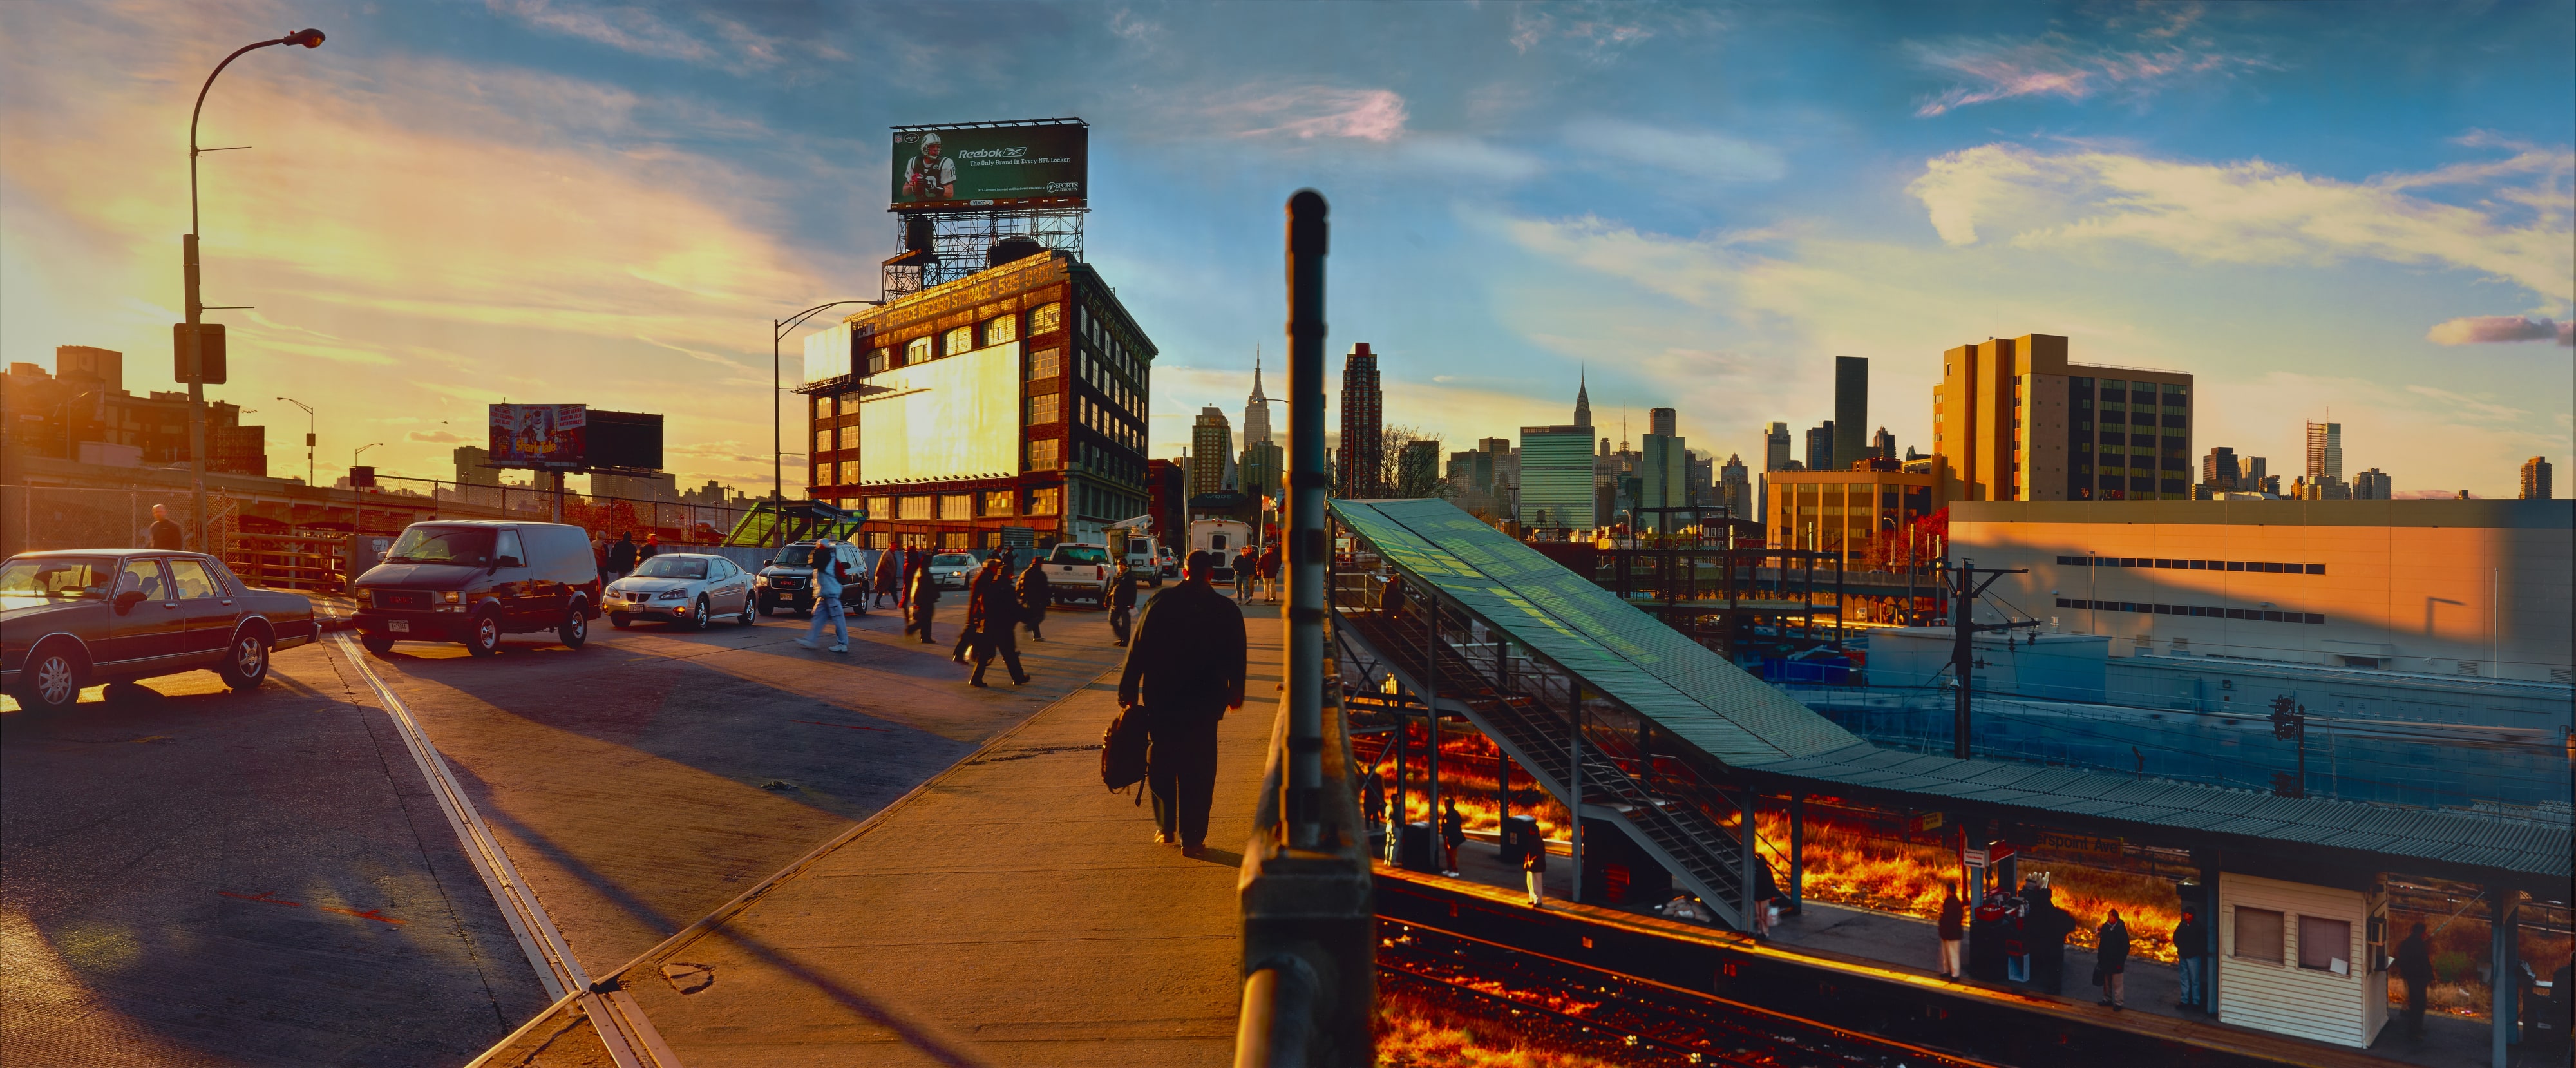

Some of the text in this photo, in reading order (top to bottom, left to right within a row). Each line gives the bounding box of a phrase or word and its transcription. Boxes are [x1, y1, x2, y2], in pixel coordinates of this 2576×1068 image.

[958, 149, 1003, 158] Reebok
[952, 281, 992, 308] STORAGE
[516, 439, 556, 453] Shark Tale
[2094, 837, 2117, 853] Ave
